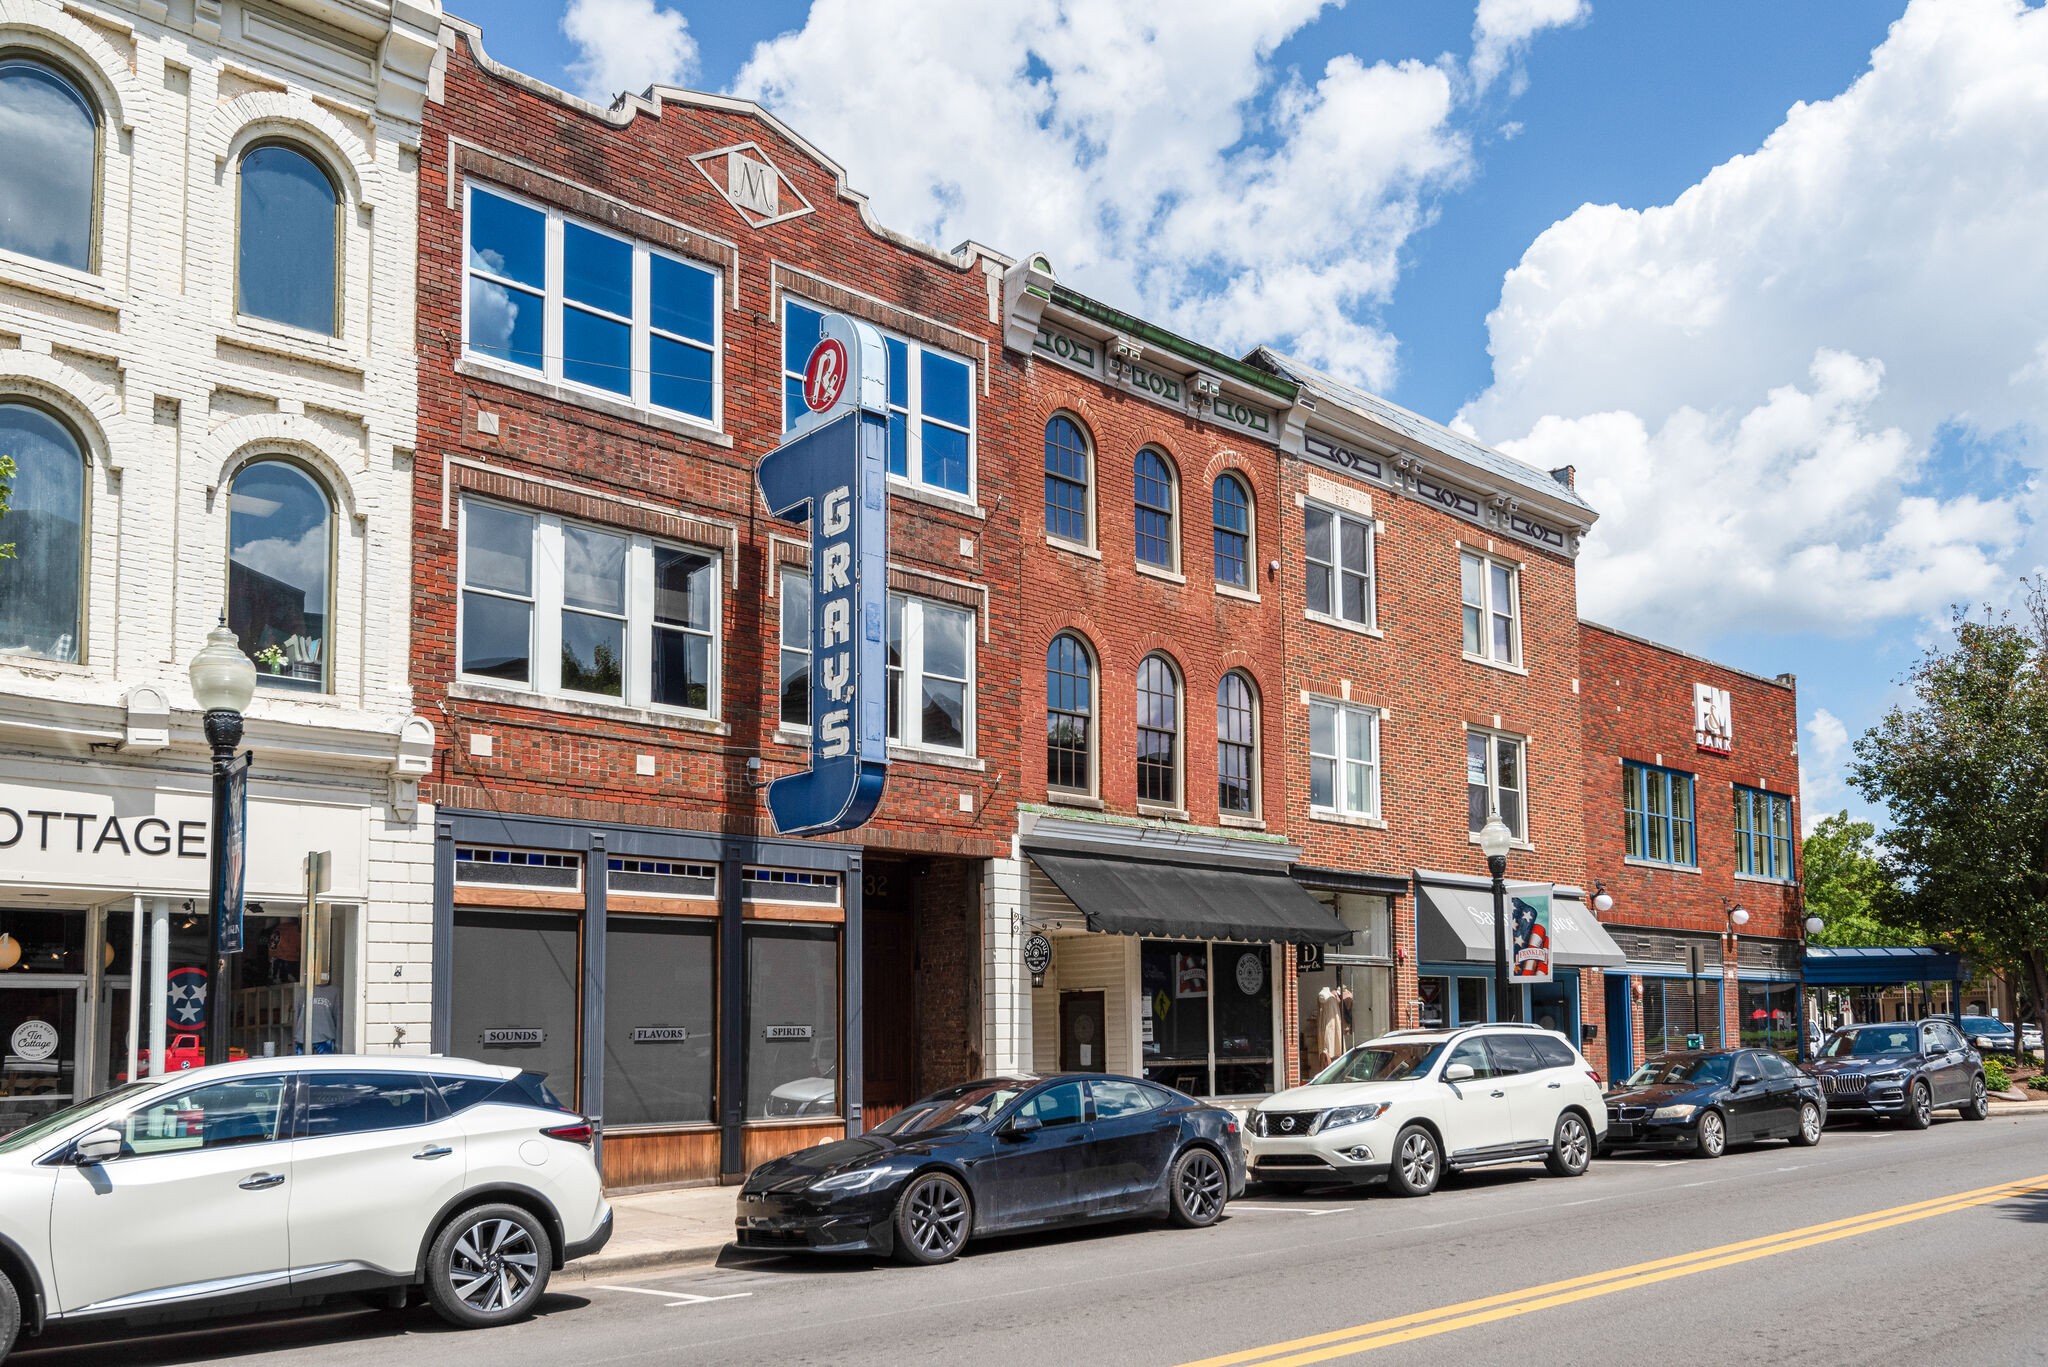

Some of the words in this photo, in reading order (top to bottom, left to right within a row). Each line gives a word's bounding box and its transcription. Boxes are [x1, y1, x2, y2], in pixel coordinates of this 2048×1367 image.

[734, 162, 774, 211] M
[819, 485, 855, 760] GRAY'S
[1693, 682, 1732, 738] F&M
[1696, 732, 1732, 752] BANK
[1032, 938, 1048, 956] JOYFUL
[27, 1030, 42, 1040] Tin
[490, 1031, 538, 1041] SOUNDS
[637, 1029, 683, 1039] FLAVORS
[772, 1027, 806, 1036] SPIRITS
[17, 1038, 52, 1050] Cottage
